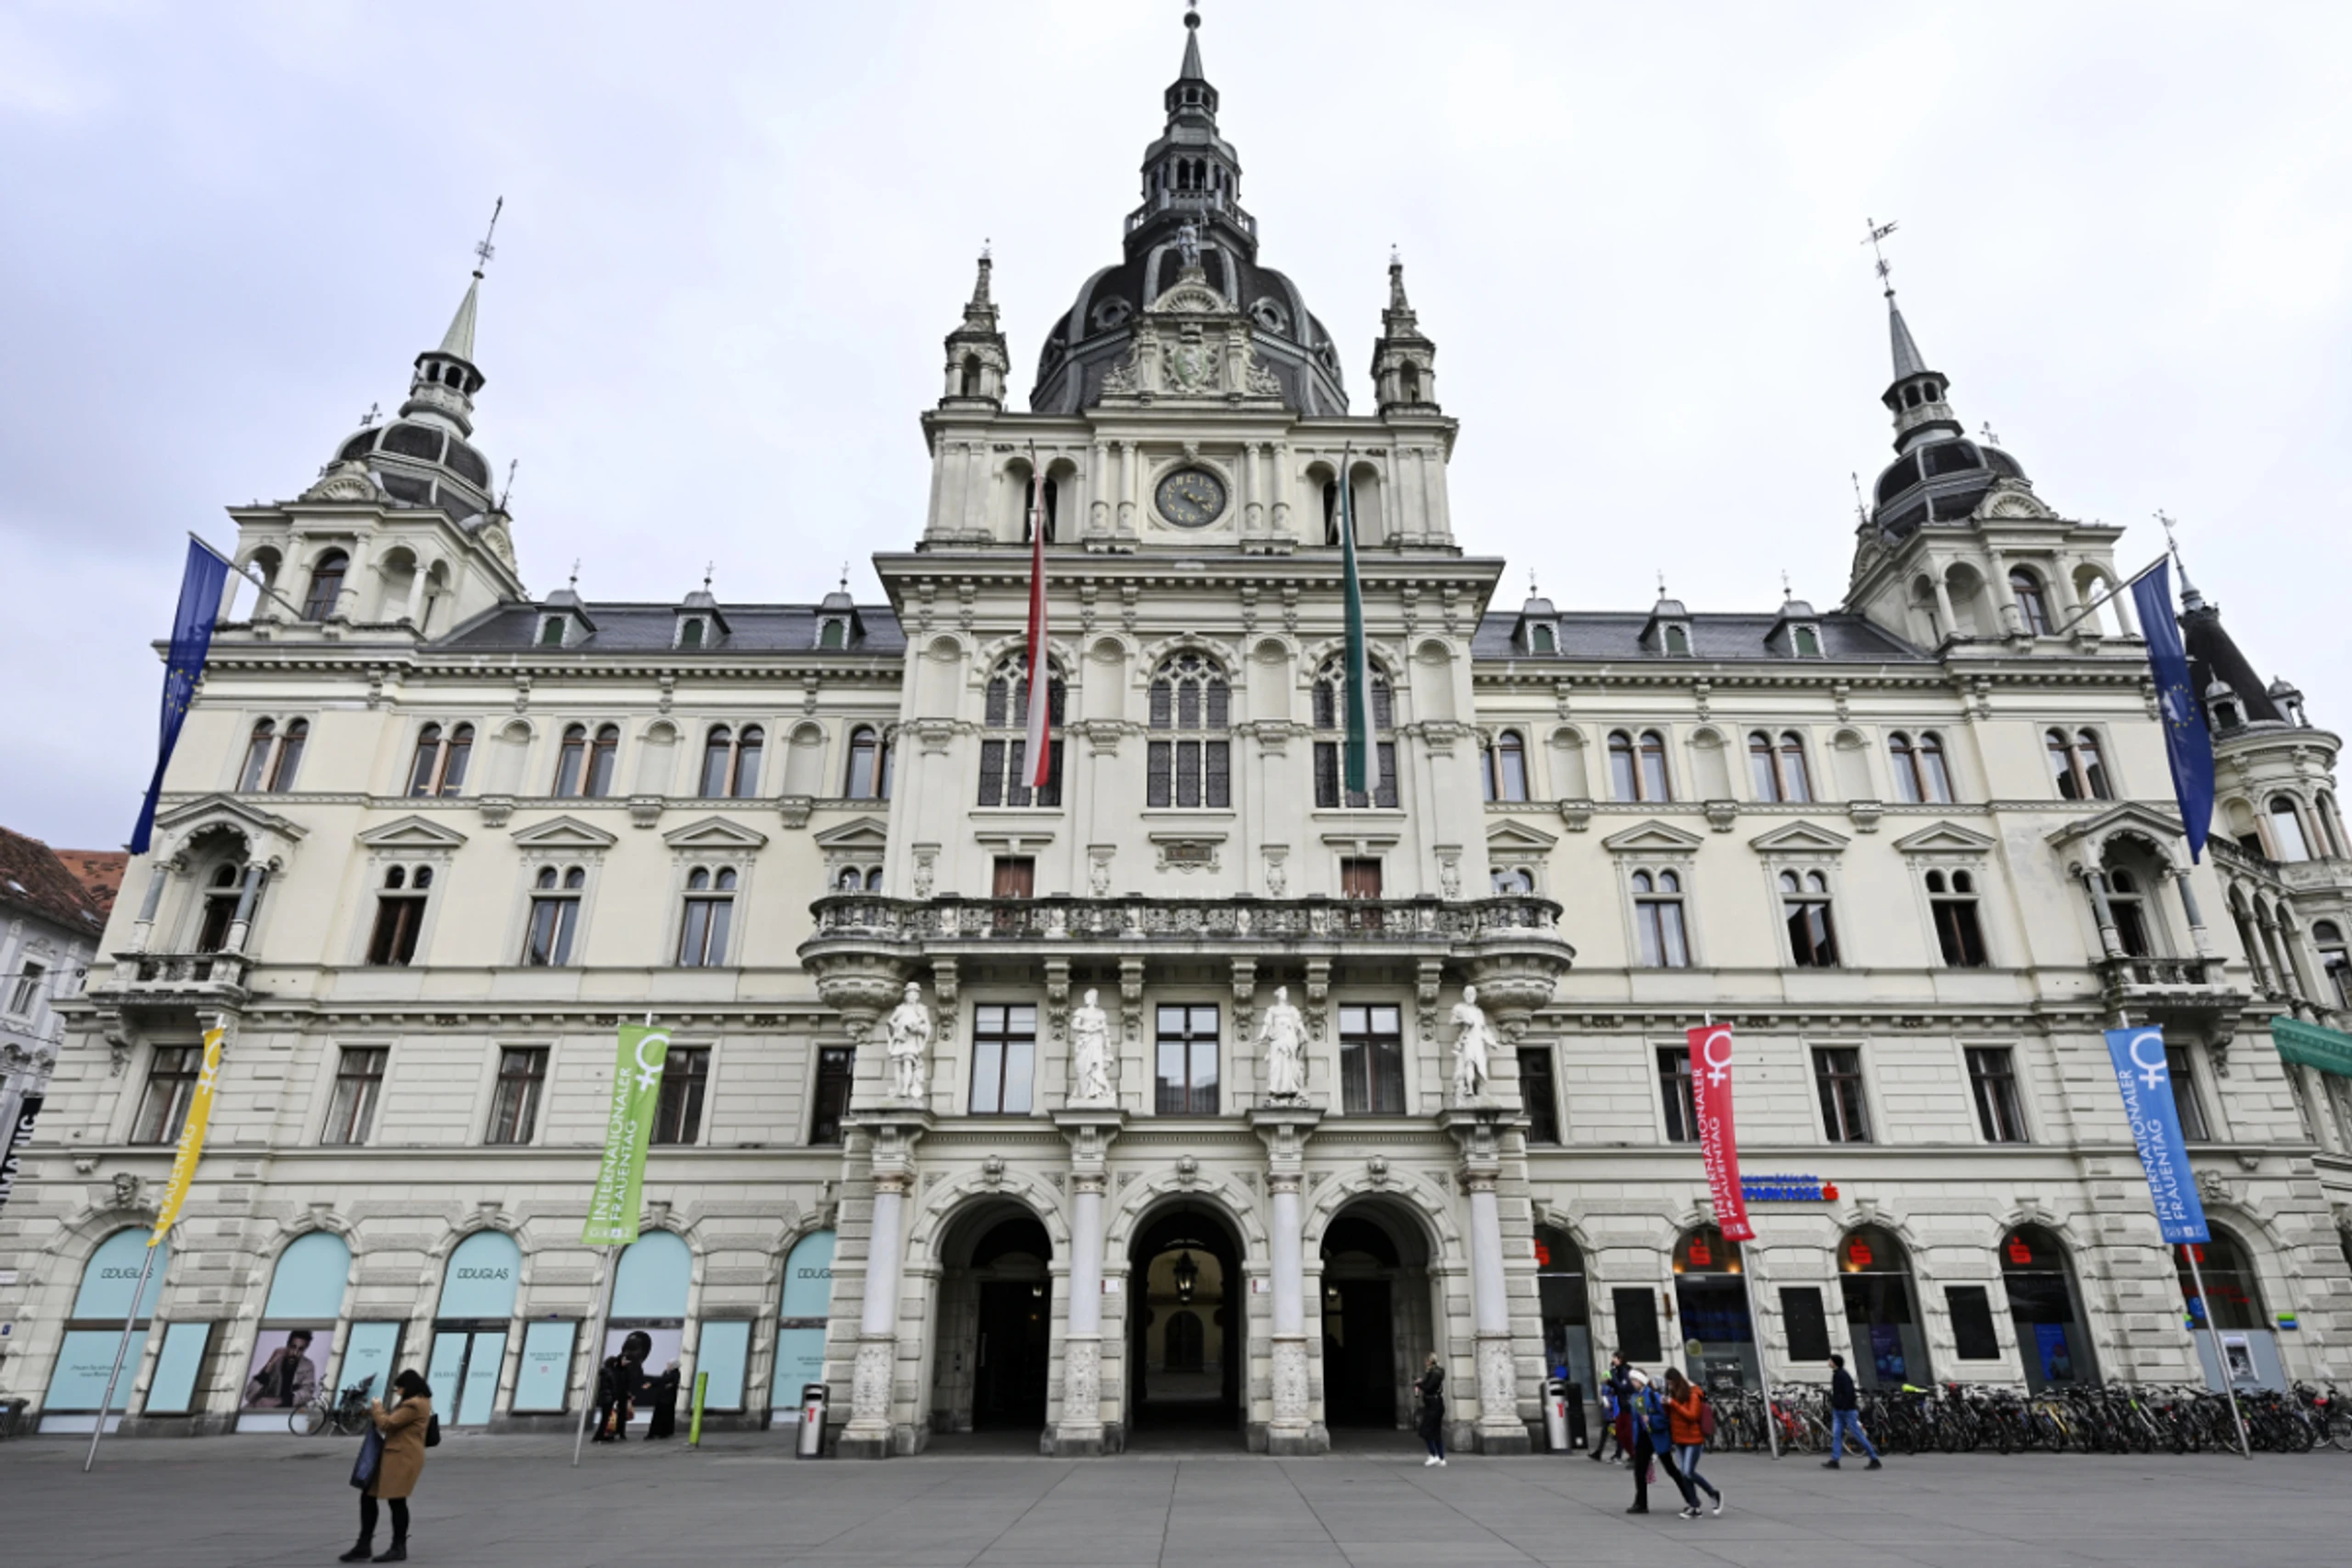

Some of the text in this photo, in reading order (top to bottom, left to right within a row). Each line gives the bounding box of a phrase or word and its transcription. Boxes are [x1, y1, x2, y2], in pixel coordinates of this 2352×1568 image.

[592, 1067, 632, 1221] INTERNATIONALER
[610, 1120, 639, 1221] FRAUENTAG
[1692, 1067, 1728, 1219] INTERNATIONALER
[1709, 1116, 1737, 1217] FRAUENTAG
[2119, 1069, 2173, 1221] INTERNATIONALER
[2146, 1118, 2188, 1221] FRAUENTAG
[457, 1268, 509, 1280] DOUGLAS
